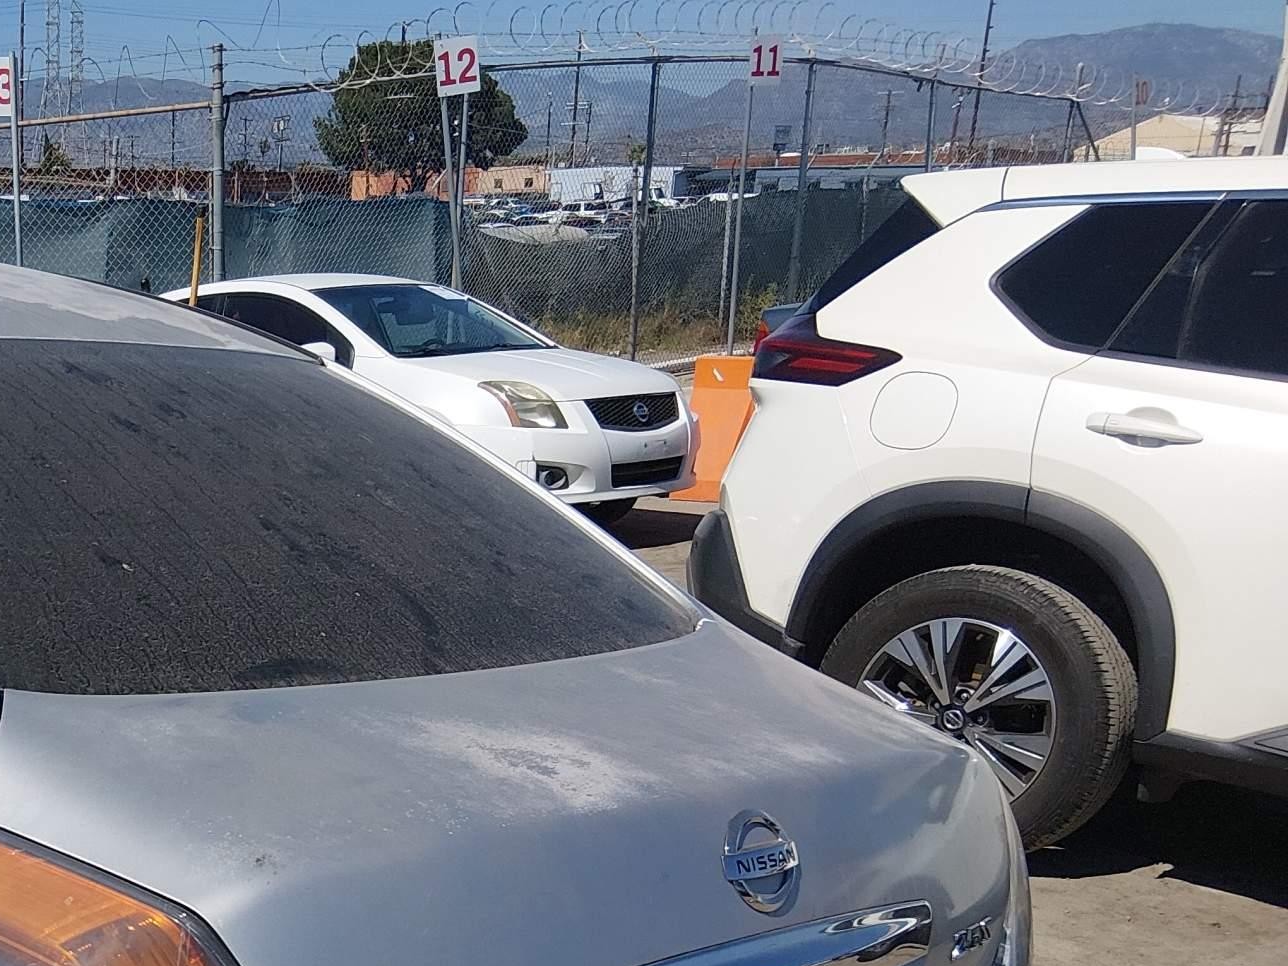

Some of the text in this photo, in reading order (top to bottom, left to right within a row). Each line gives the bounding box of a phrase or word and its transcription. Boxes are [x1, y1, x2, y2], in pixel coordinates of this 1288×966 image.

[437, 46, 476, 86] 12
[751, 44, 780, 77] 11
[735, 848, 796, 875] NISSAN
